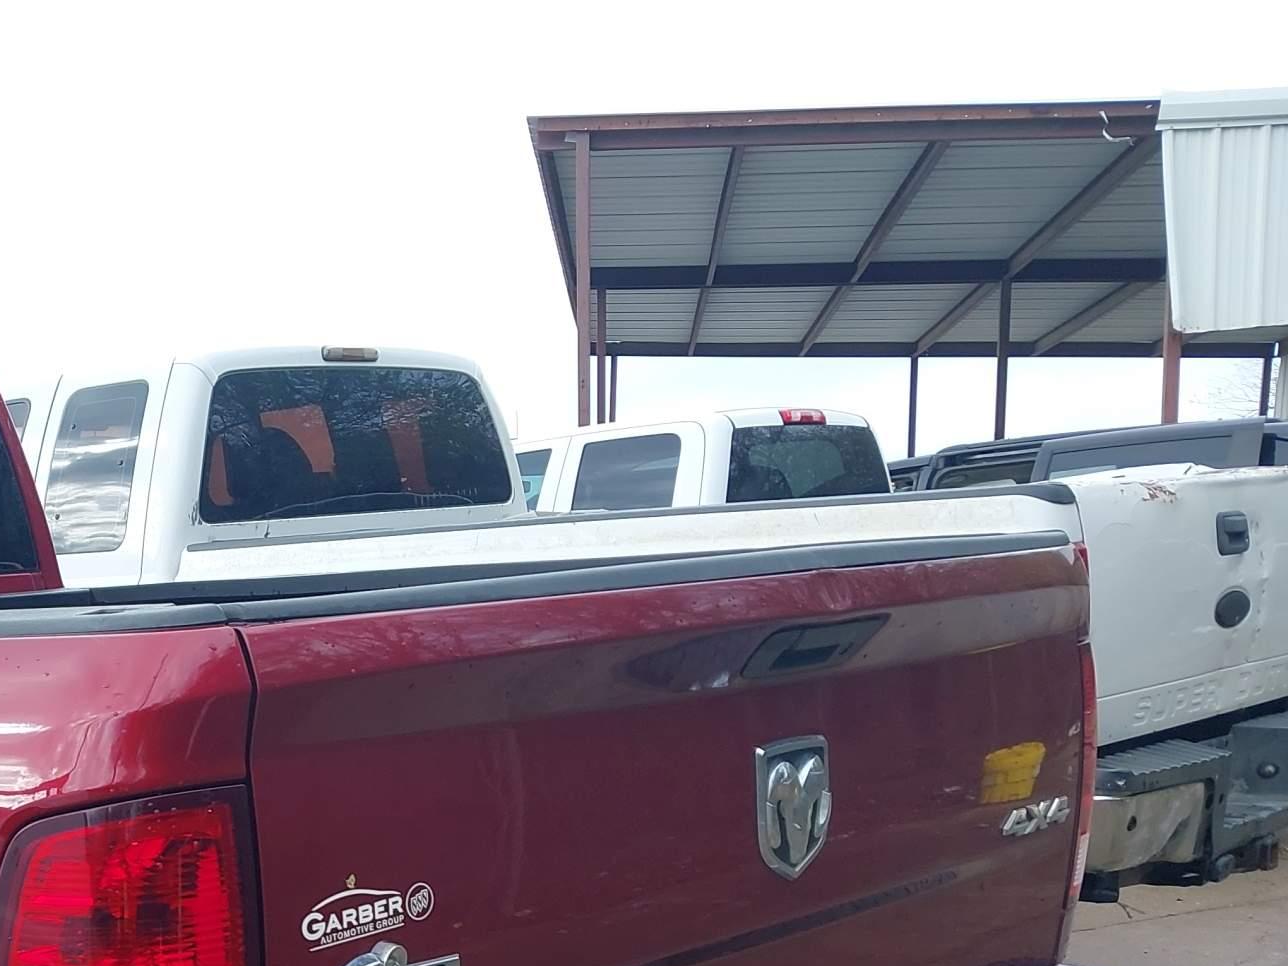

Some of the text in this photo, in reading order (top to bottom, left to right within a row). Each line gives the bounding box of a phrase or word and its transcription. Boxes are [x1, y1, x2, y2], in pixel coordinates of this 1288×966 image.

[1131, 678, 1225, 727] SUPER
[301, 895, 404, 941] GARBER
[320, 914, 405, 945] AUTOMOTIVE GROUP
